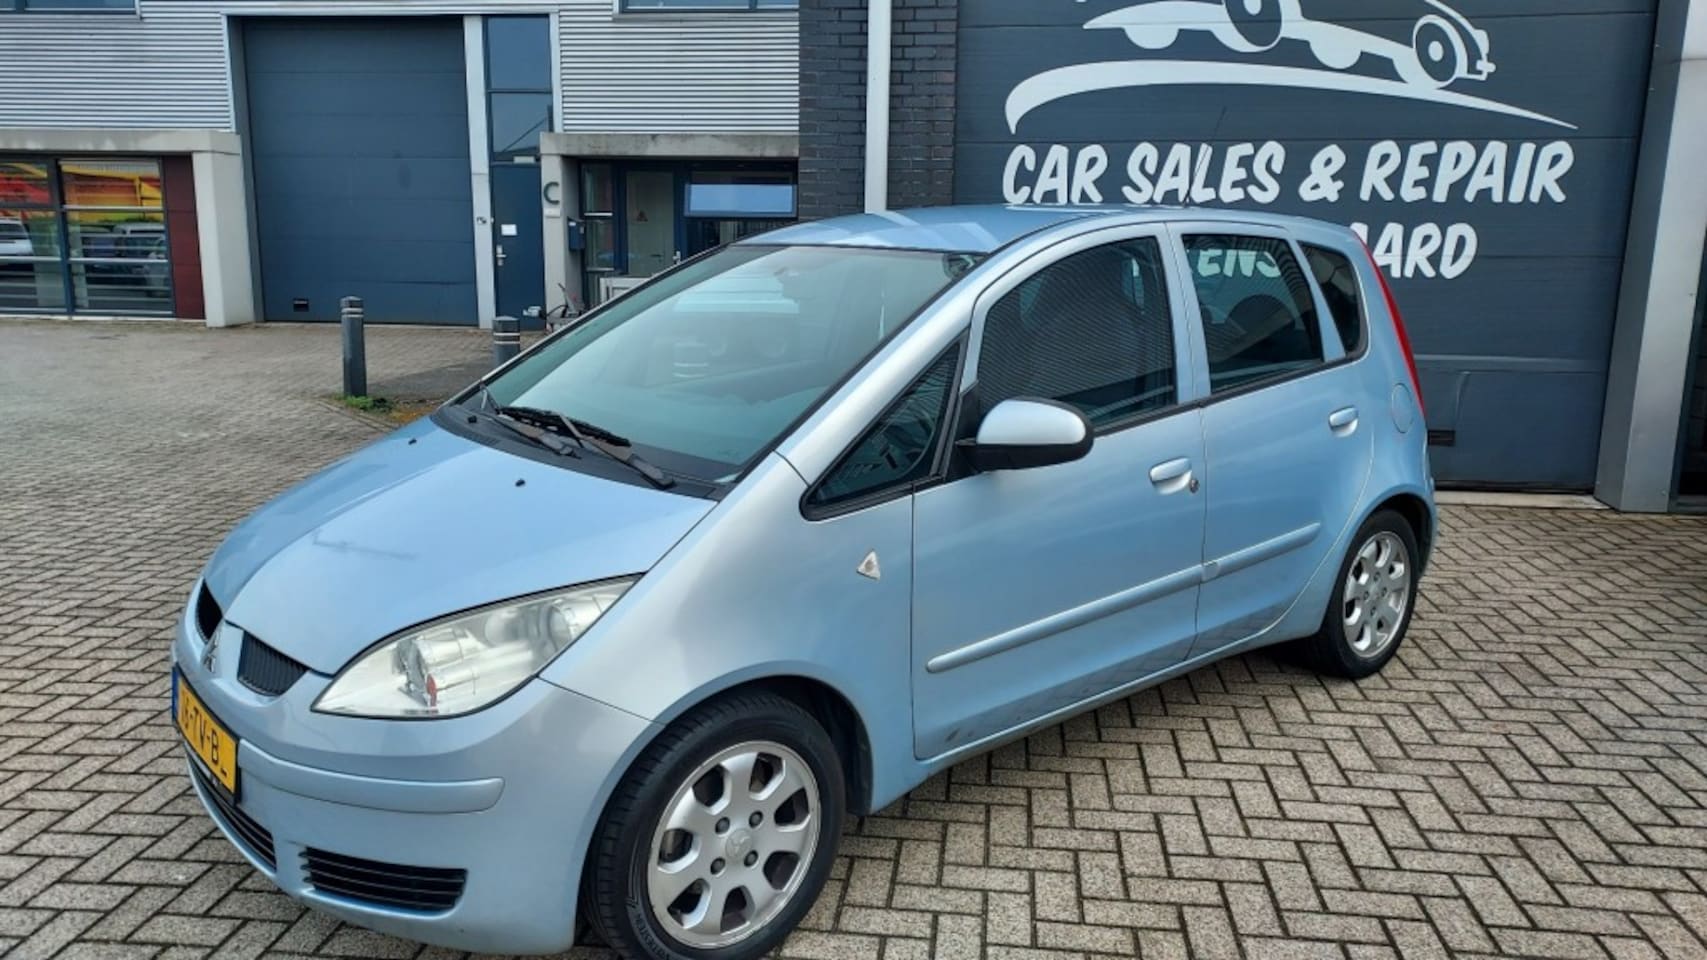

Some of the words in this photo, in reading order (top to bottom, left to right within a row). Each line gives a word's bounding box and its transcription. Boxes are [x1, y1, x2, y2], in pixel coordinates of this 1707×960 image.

[543, 181, 560, 206] C
[1002, 143, 1108, 205] CAR
[1121, 140, 1285, 205] SALES
[1298, 143, 1347, 202] &
[1359, 139, 1574, 203] REPAIR
